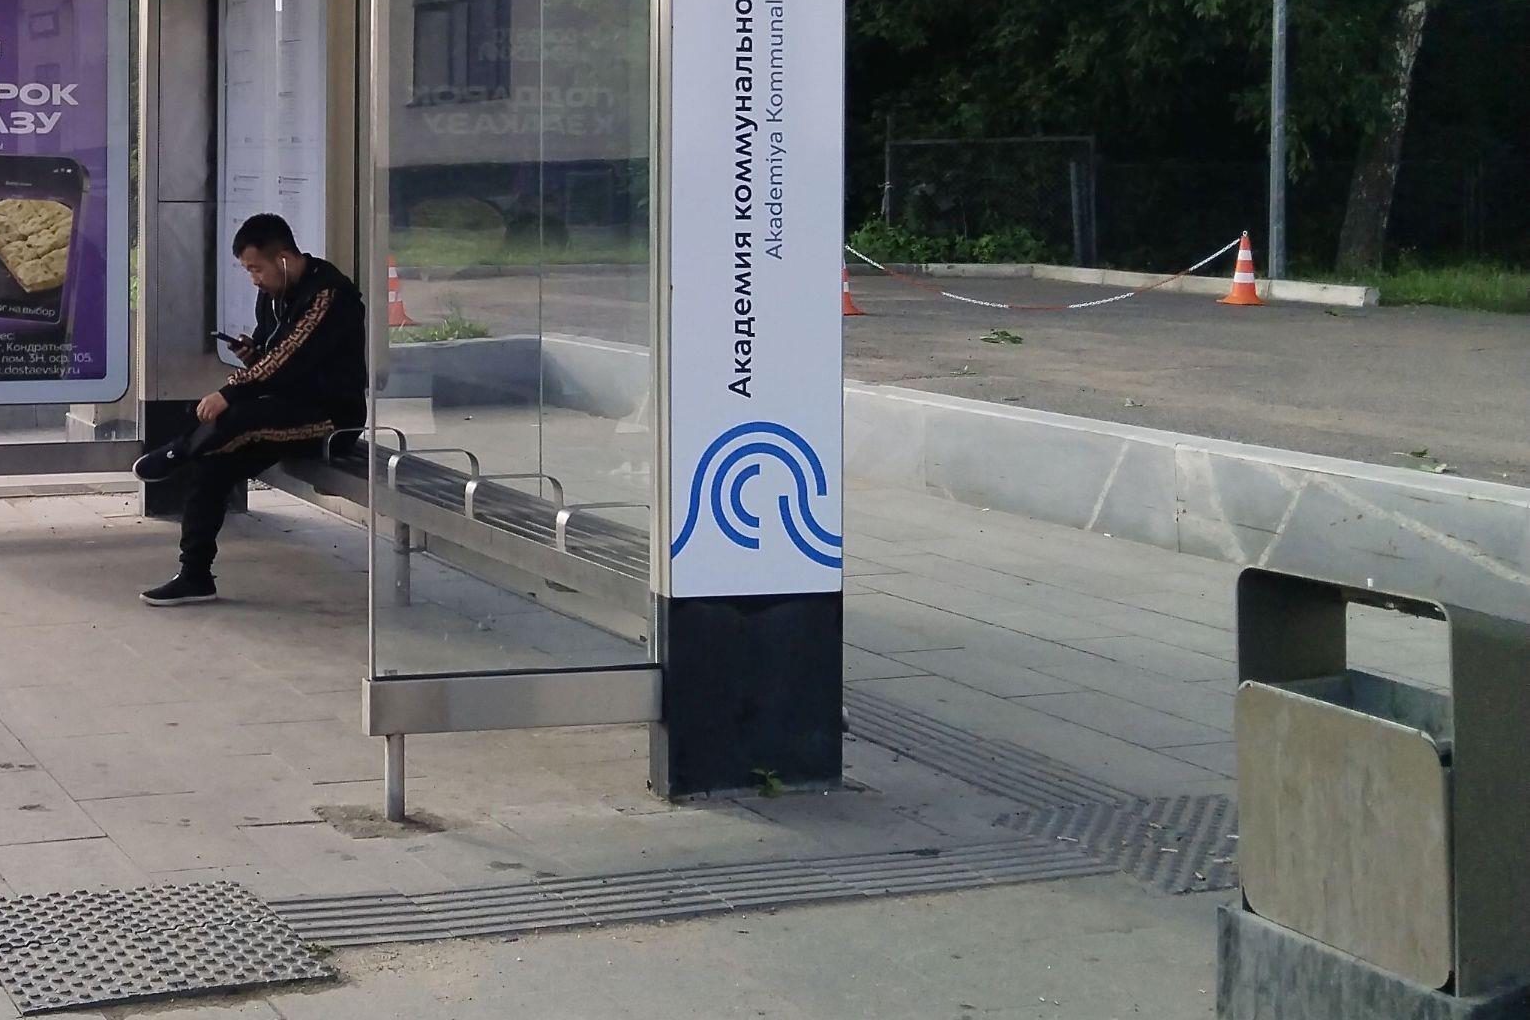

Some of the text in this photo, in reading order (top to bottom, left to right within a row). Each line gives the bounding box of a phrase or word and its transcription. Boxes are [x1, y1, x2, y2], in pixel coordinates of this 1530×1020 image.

[764, 131, 787, 260] Akademiya
[9, 305, 21, 313] на
[22, 306, 56, 317] выбор
[728, 232, 755, 398] Академия
